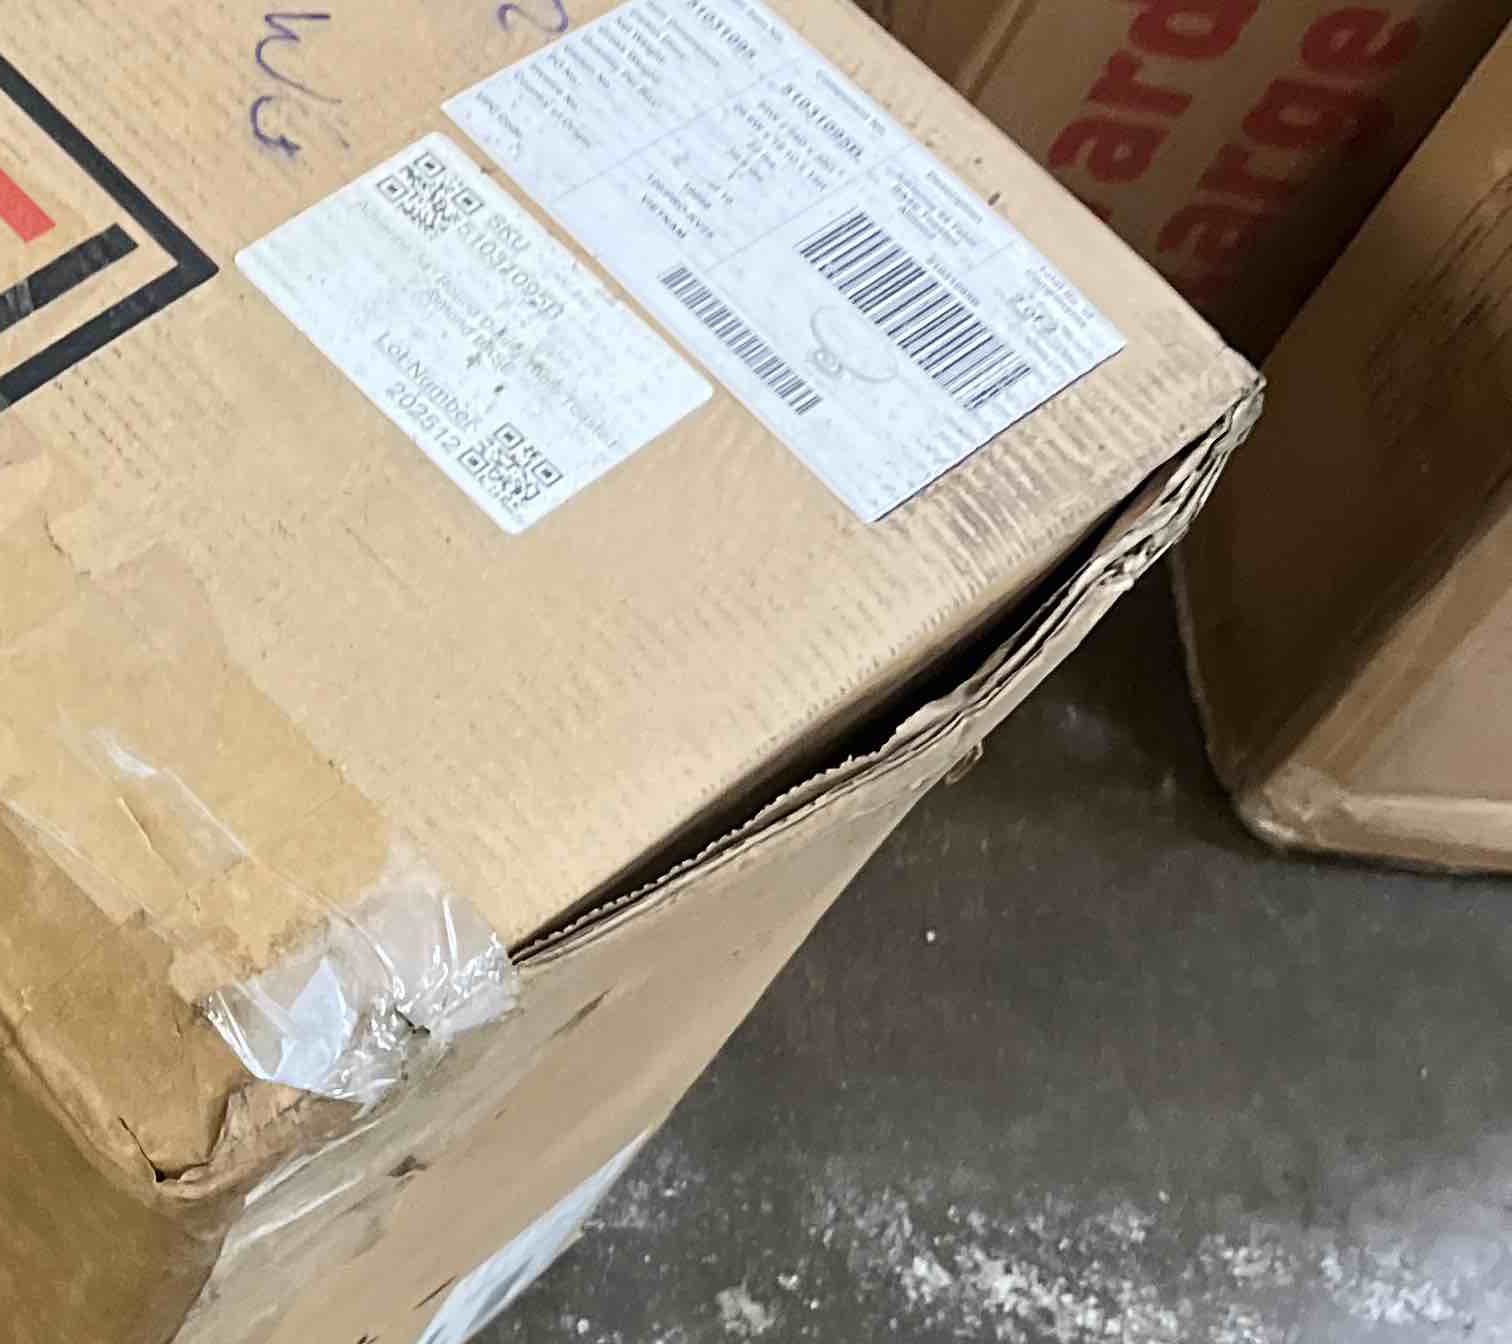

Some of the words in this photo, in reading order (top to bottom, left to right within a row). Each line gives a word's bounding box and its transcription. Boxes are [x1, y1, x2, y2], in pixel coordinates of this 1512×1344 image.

[482, 211, 533, 254] SKU
[371, 330, 412, 365] Lot
[399, 357, 482, 433] Number
[383, 379, 464, 454] 202512
